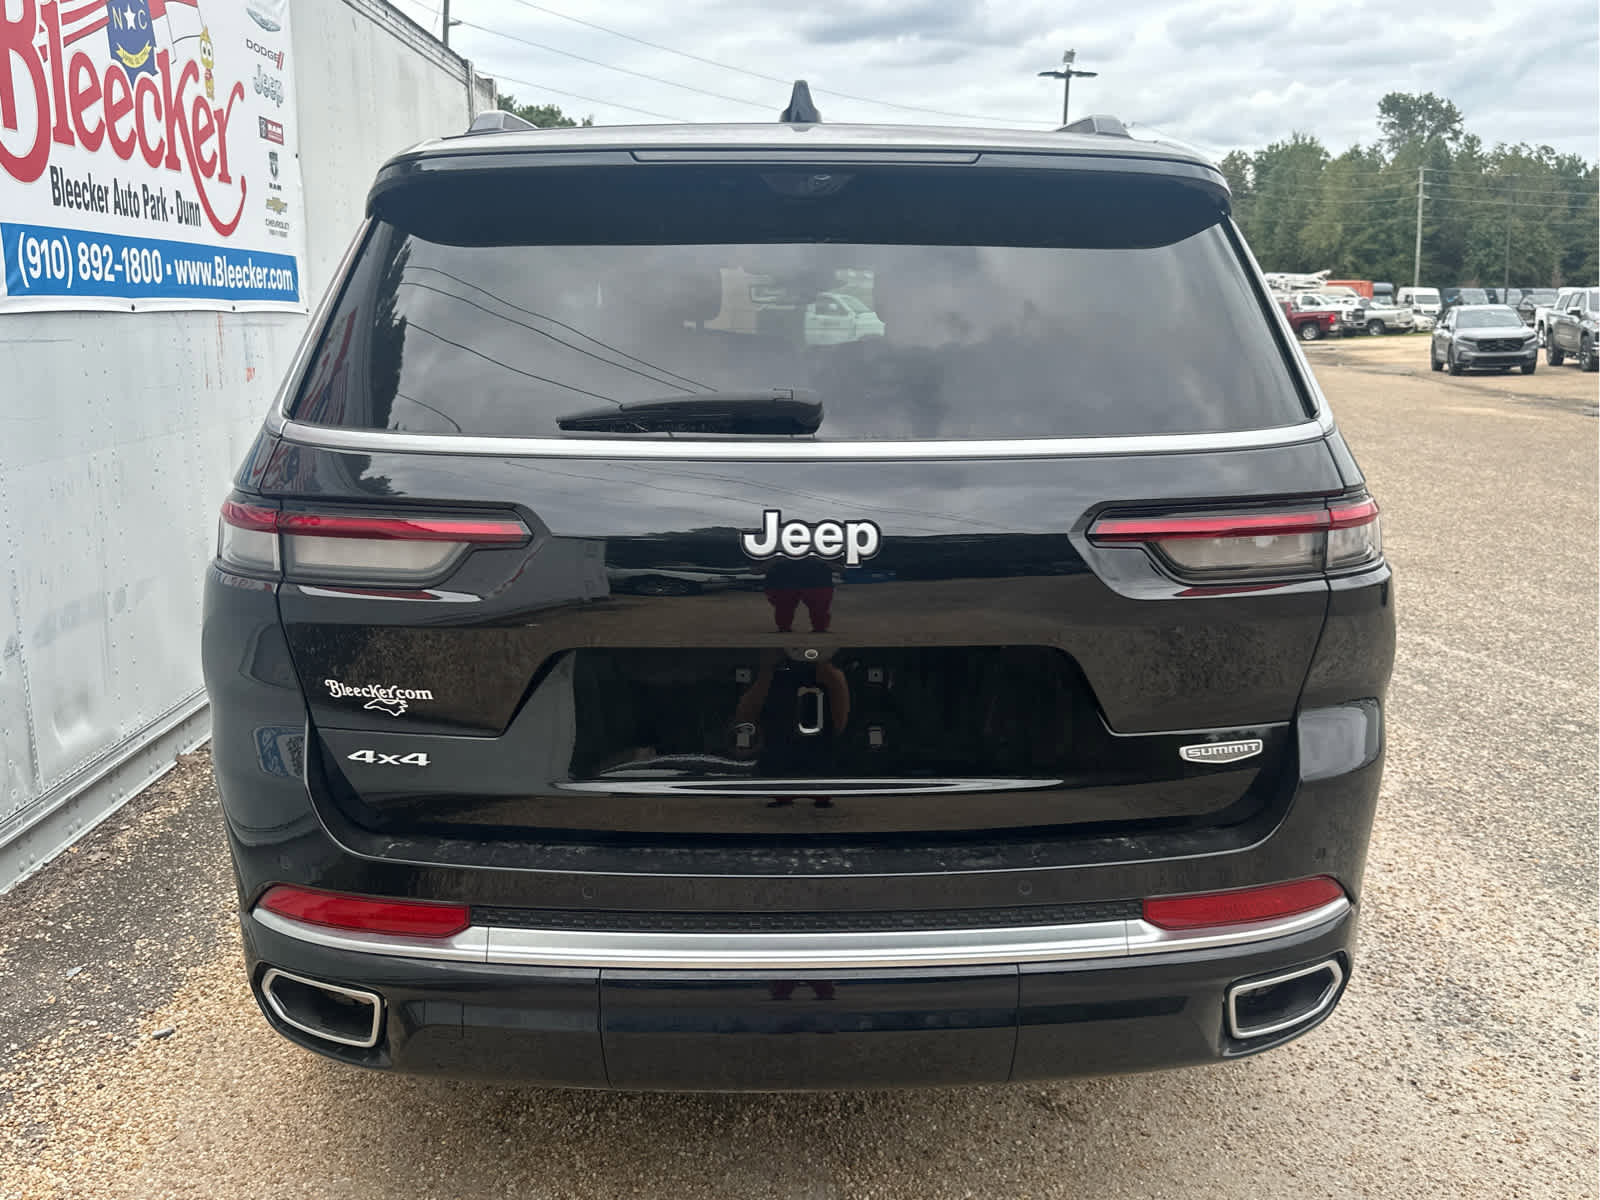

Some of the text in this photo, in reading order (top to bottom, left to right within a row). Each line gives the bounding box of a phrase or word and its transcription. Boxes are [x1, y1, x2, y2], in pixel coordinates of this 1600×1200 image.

[246, 38, 280, 62] DODGE
[253, 64, 284, 108] Jeep
[50, 165, 109, 214] Bleecker
[113, 178, 141, 219] Auto
[142, 184, 169, 222] Park
[175, 190, 201, 227] Dunn
[18, 232, 73, 288] (910)
[78, 242, 163, 284] 892-1800
[175, 255, 294, 291] www.Bleecker.com
[742, 510, 880, 567] Jeep
[324, 679, 433, 702] Bleecker.com
[347, 750, 431, 766] 4x4
[1187, 743, 1259, 757] SUMMIT
